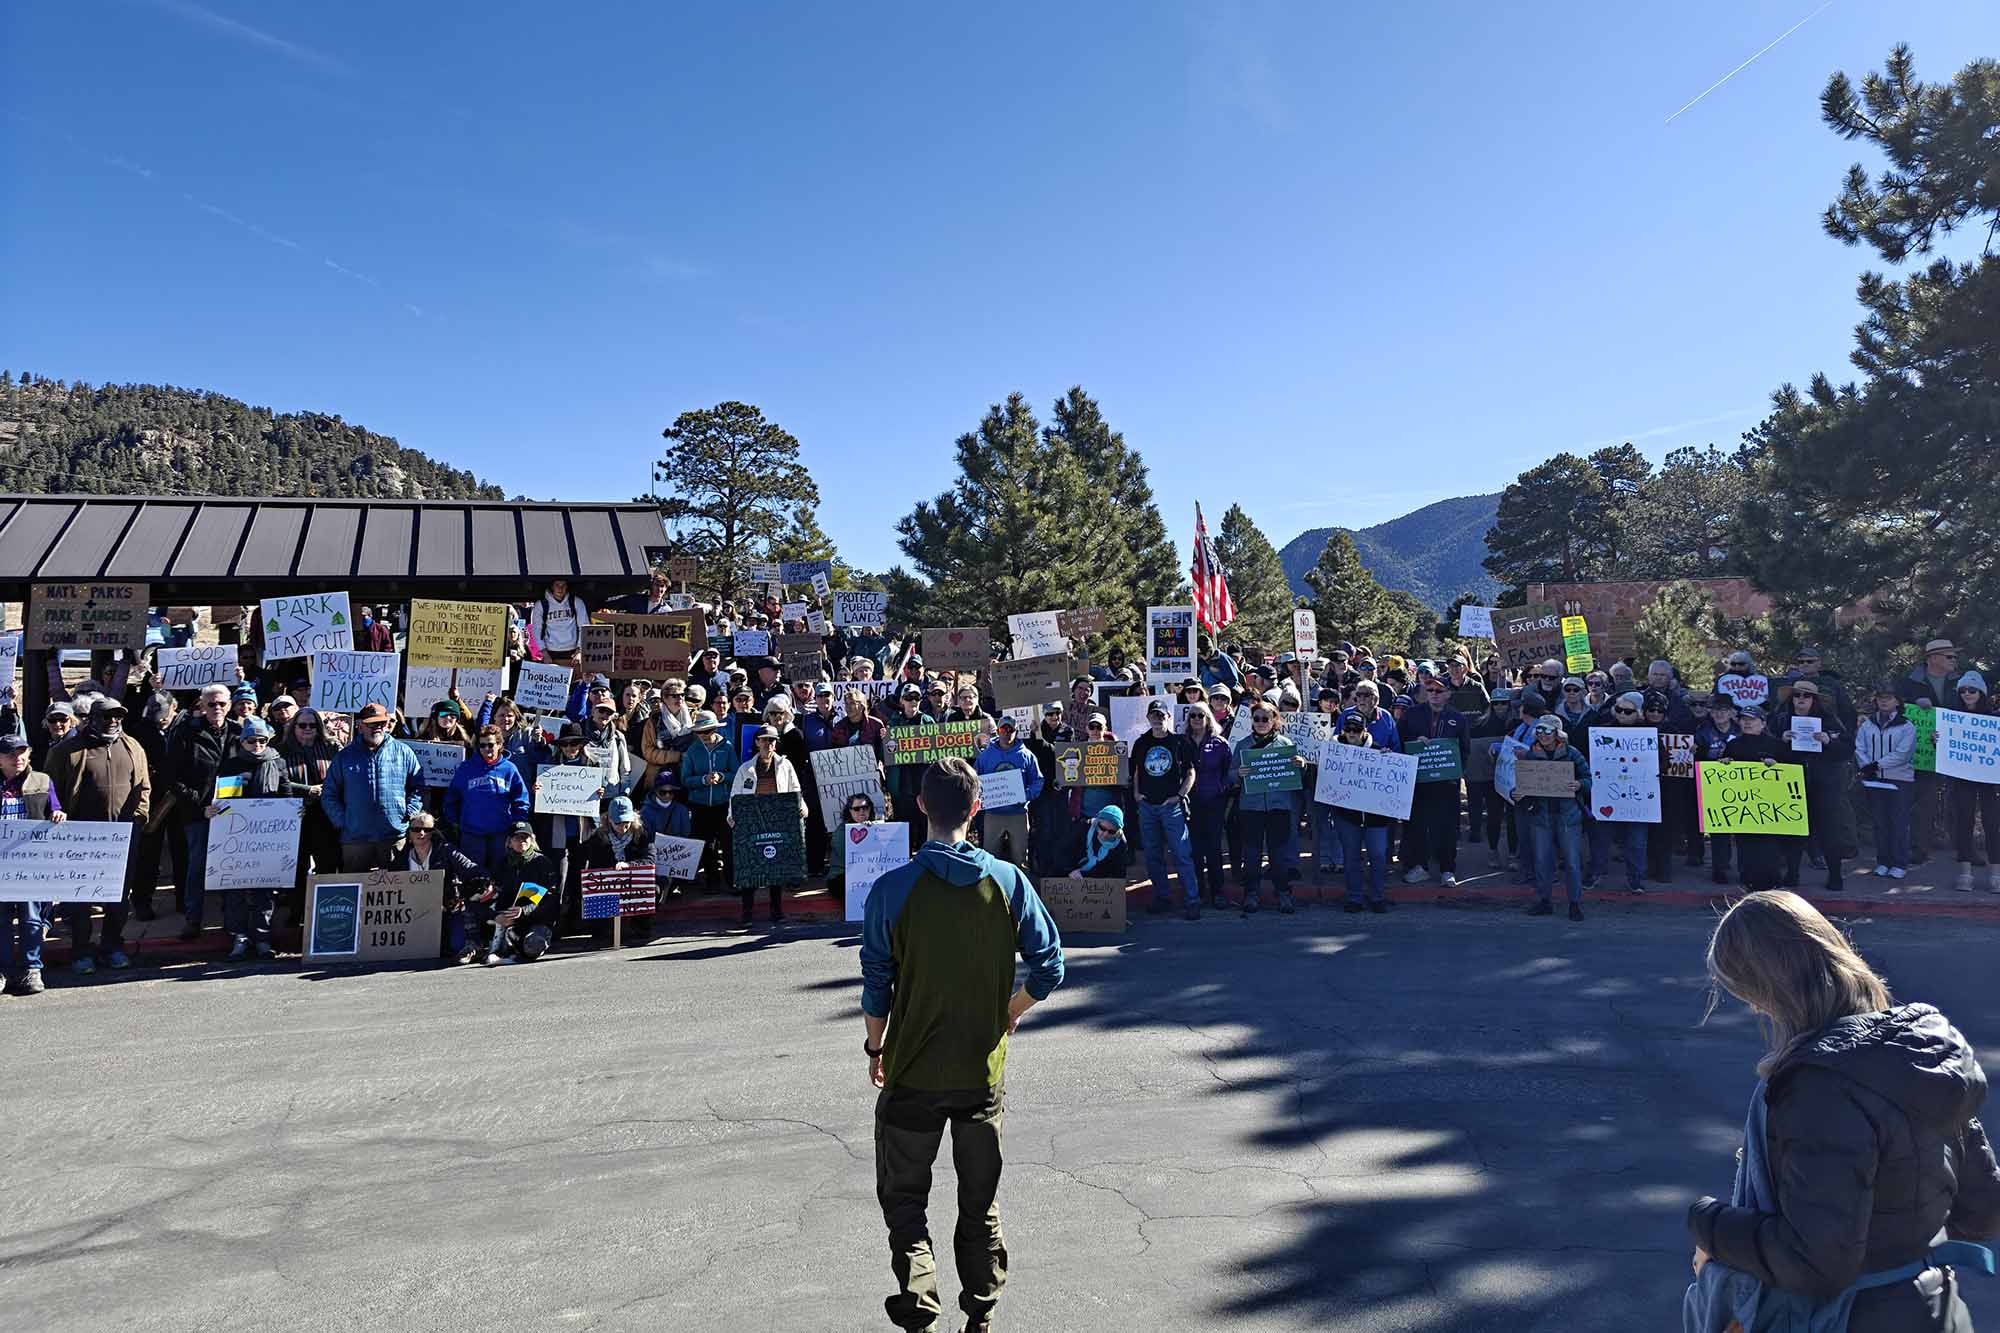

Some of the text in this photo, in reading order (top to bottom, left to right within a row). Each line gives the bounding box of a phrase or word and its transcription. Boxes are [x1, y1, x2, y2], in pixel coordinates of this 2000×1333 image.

[91, 587, 133, 599] PARKS
[836, 592, 879, 603] PROTECT
[276, 595, 334, 617] PARK
[457, 604, 482, 612] FALLEN
[841, 603, 884, 612] PUBLIC
[844, 613, 884, 623] LANDS
[1300, 617, 1310, 626] NO
[1509, 615, 1560, 634] EXPLORE
[643, 624, 687, 639] DANGER
[1160, 629, 1183, 638] SAVE
[1296, 630, 1315, 640] PARKING
[269, 630, 347, 656] TAX CUT
[176, 647, 225, 660] GOOD
[1157, 646, 1185, 656] PARKS
[319, 652, 389, 673] PROTECT
[160, 663, 235, 687] TROUBLE
[457, 677, 494, 688] LANDS
[1723, 679, 1766, 692] THANK
[321, 681, 391, 709] PARKS
[1942, 712, 1965, 724] HEY
[890, 720, 981, 739] SAVE OUR PARKS!
[1949, 728, 1997, 743] I HEAR
[899, 732, 973, 751] FIRE DOGE
[1949, 740, 1986, 753] BISON
[894, 746, 974, 764] NOT RANGERS
[1949, 751, 1995, 766] FUN TO
[1358, 764, 1382, 779] RAPE
[1387, 769, 1408, 784] OUR
[1704, 767, 1784, 785] PROTECT
[1721, 787, 1763, 802] OUR
[760, 832, 782, 840] STAND
[366, 890, 405, 906] NAT'L
[365, 908, 412, 925] PARKS
[371, 931, 406, 946] 1916
